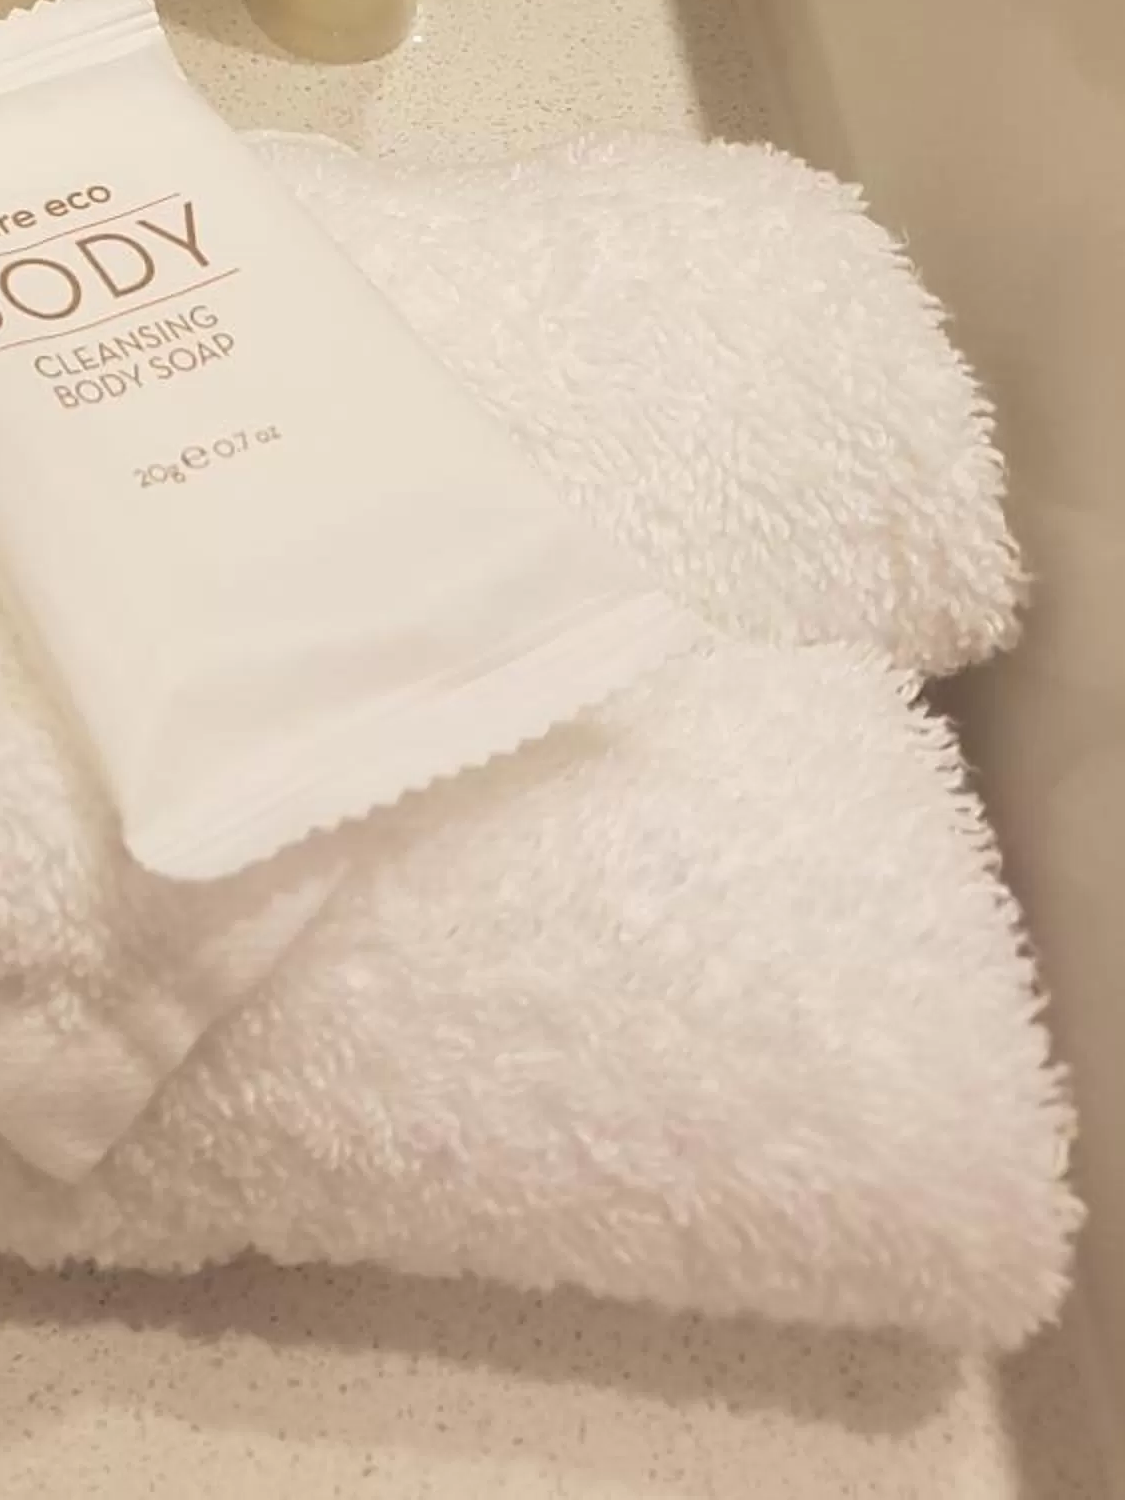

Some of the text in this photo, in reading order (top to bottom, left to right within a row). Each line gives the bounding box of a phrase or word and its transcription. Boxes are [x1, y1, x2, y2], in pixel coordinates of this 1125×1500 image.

[43, 184, 112, 219] eco
[33, 303, 219, 380] CLEANSING
[52, 331, 236, 410] BODY SOAP
[212, 428, 249, 459] 0.7
[254, 424, 283, 445] oz
